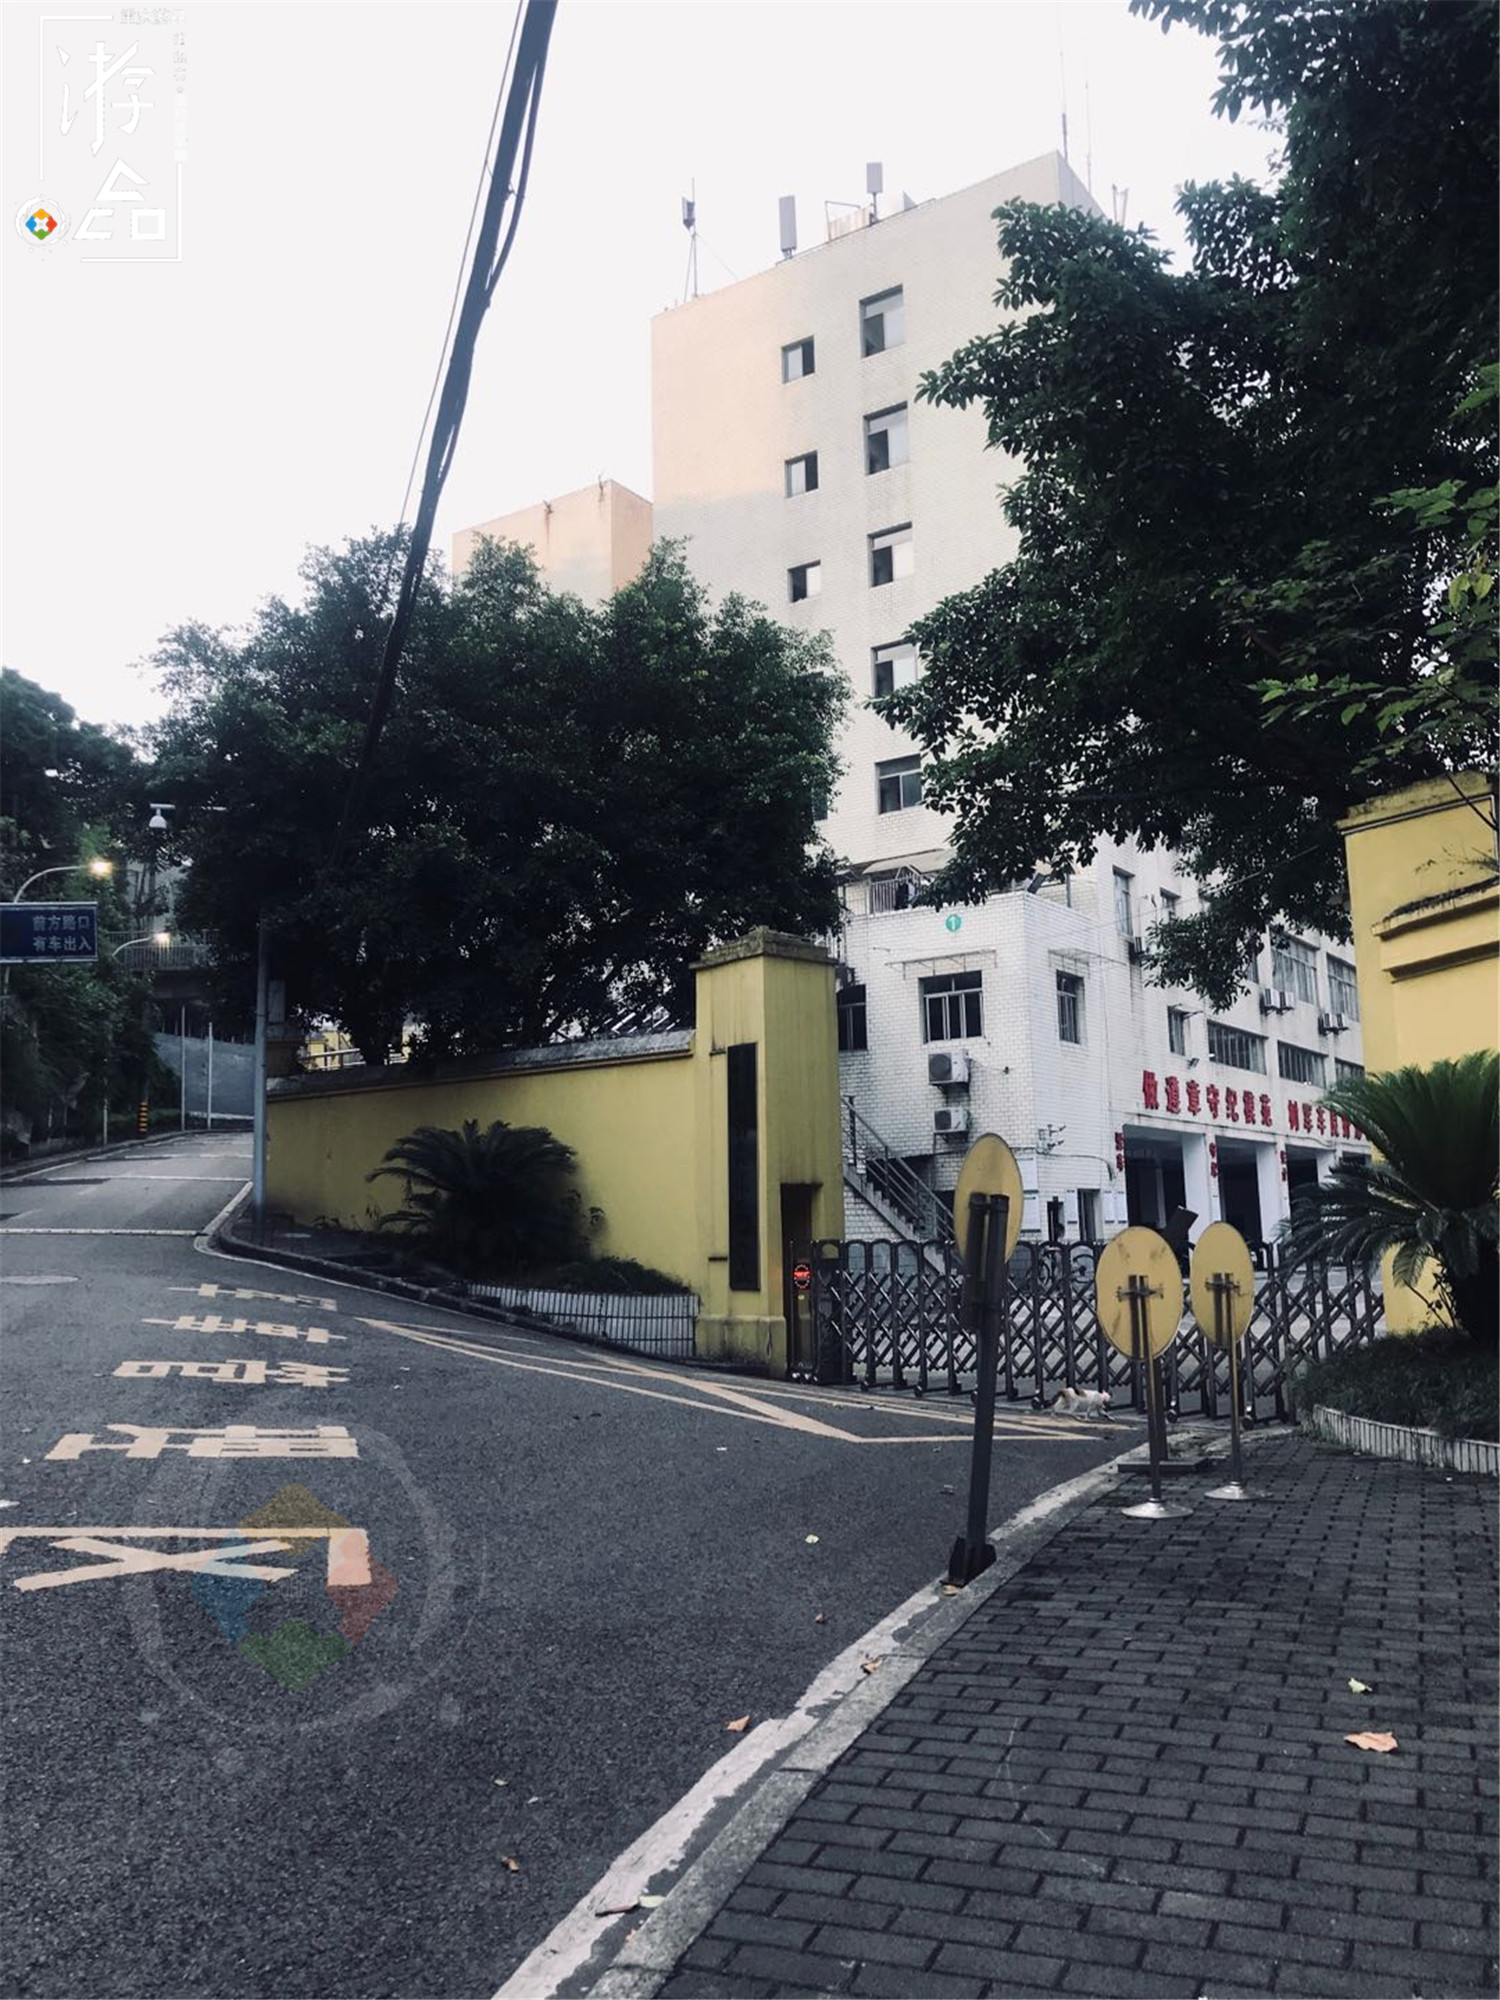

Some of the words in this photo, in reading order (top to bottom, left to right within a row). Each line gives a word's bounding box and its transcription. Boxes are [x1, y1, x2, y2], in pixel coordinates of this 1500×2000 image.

[33, 915, 90, 931] 前方路口
[33, 936, 92, 952] 有车出入
